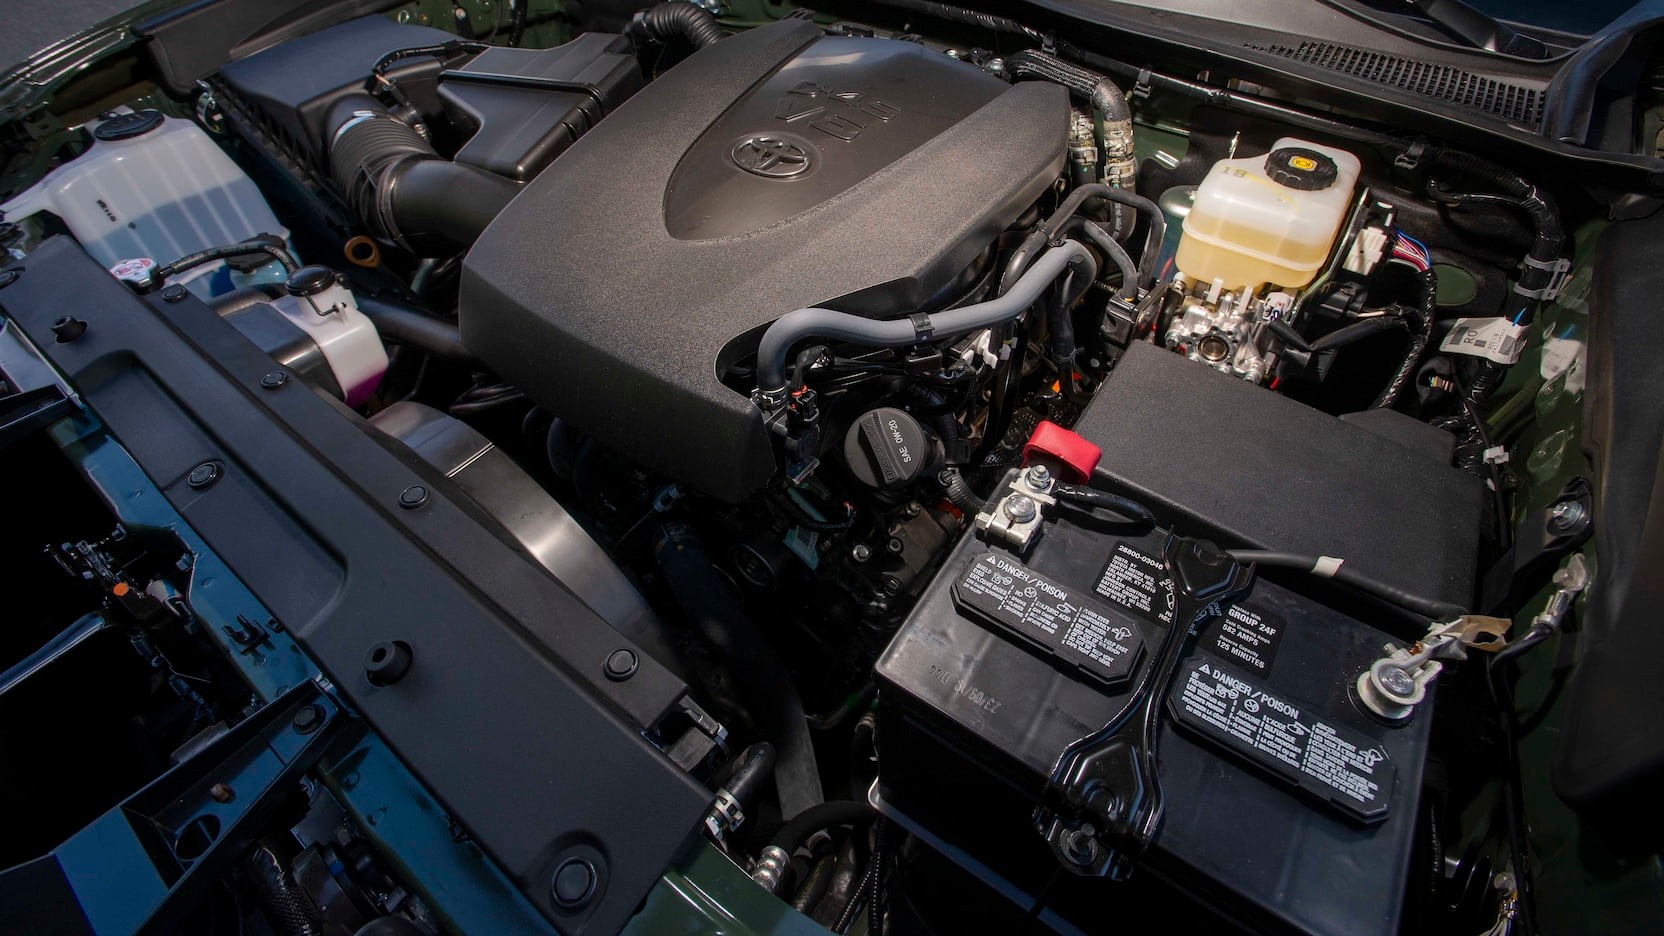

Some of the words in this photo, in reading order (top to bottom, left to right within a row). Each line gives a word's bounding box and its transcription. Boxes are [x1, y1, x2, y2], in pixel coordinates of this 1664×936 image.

[888, 420, 904, 444] 0W-20
[898, 446, 912, 463] SAE
[997, 560, 1029, 581] DANGER
[1035, 580, 1066, 600] POISON
[1222, 623, 1236, 634] 582
[1237, 631, 1258, 645] AMPS
[1228, 608, 1257, 627] GROUP
[1258, 623, 1275, 636] 24F
[1216, 639, 1230, 650] 125
[1231, 647, 1264, 668] MINUTES
[1212, 669, 1251, 696] DANGER
[1261, 693, 1298, 719] POISON
